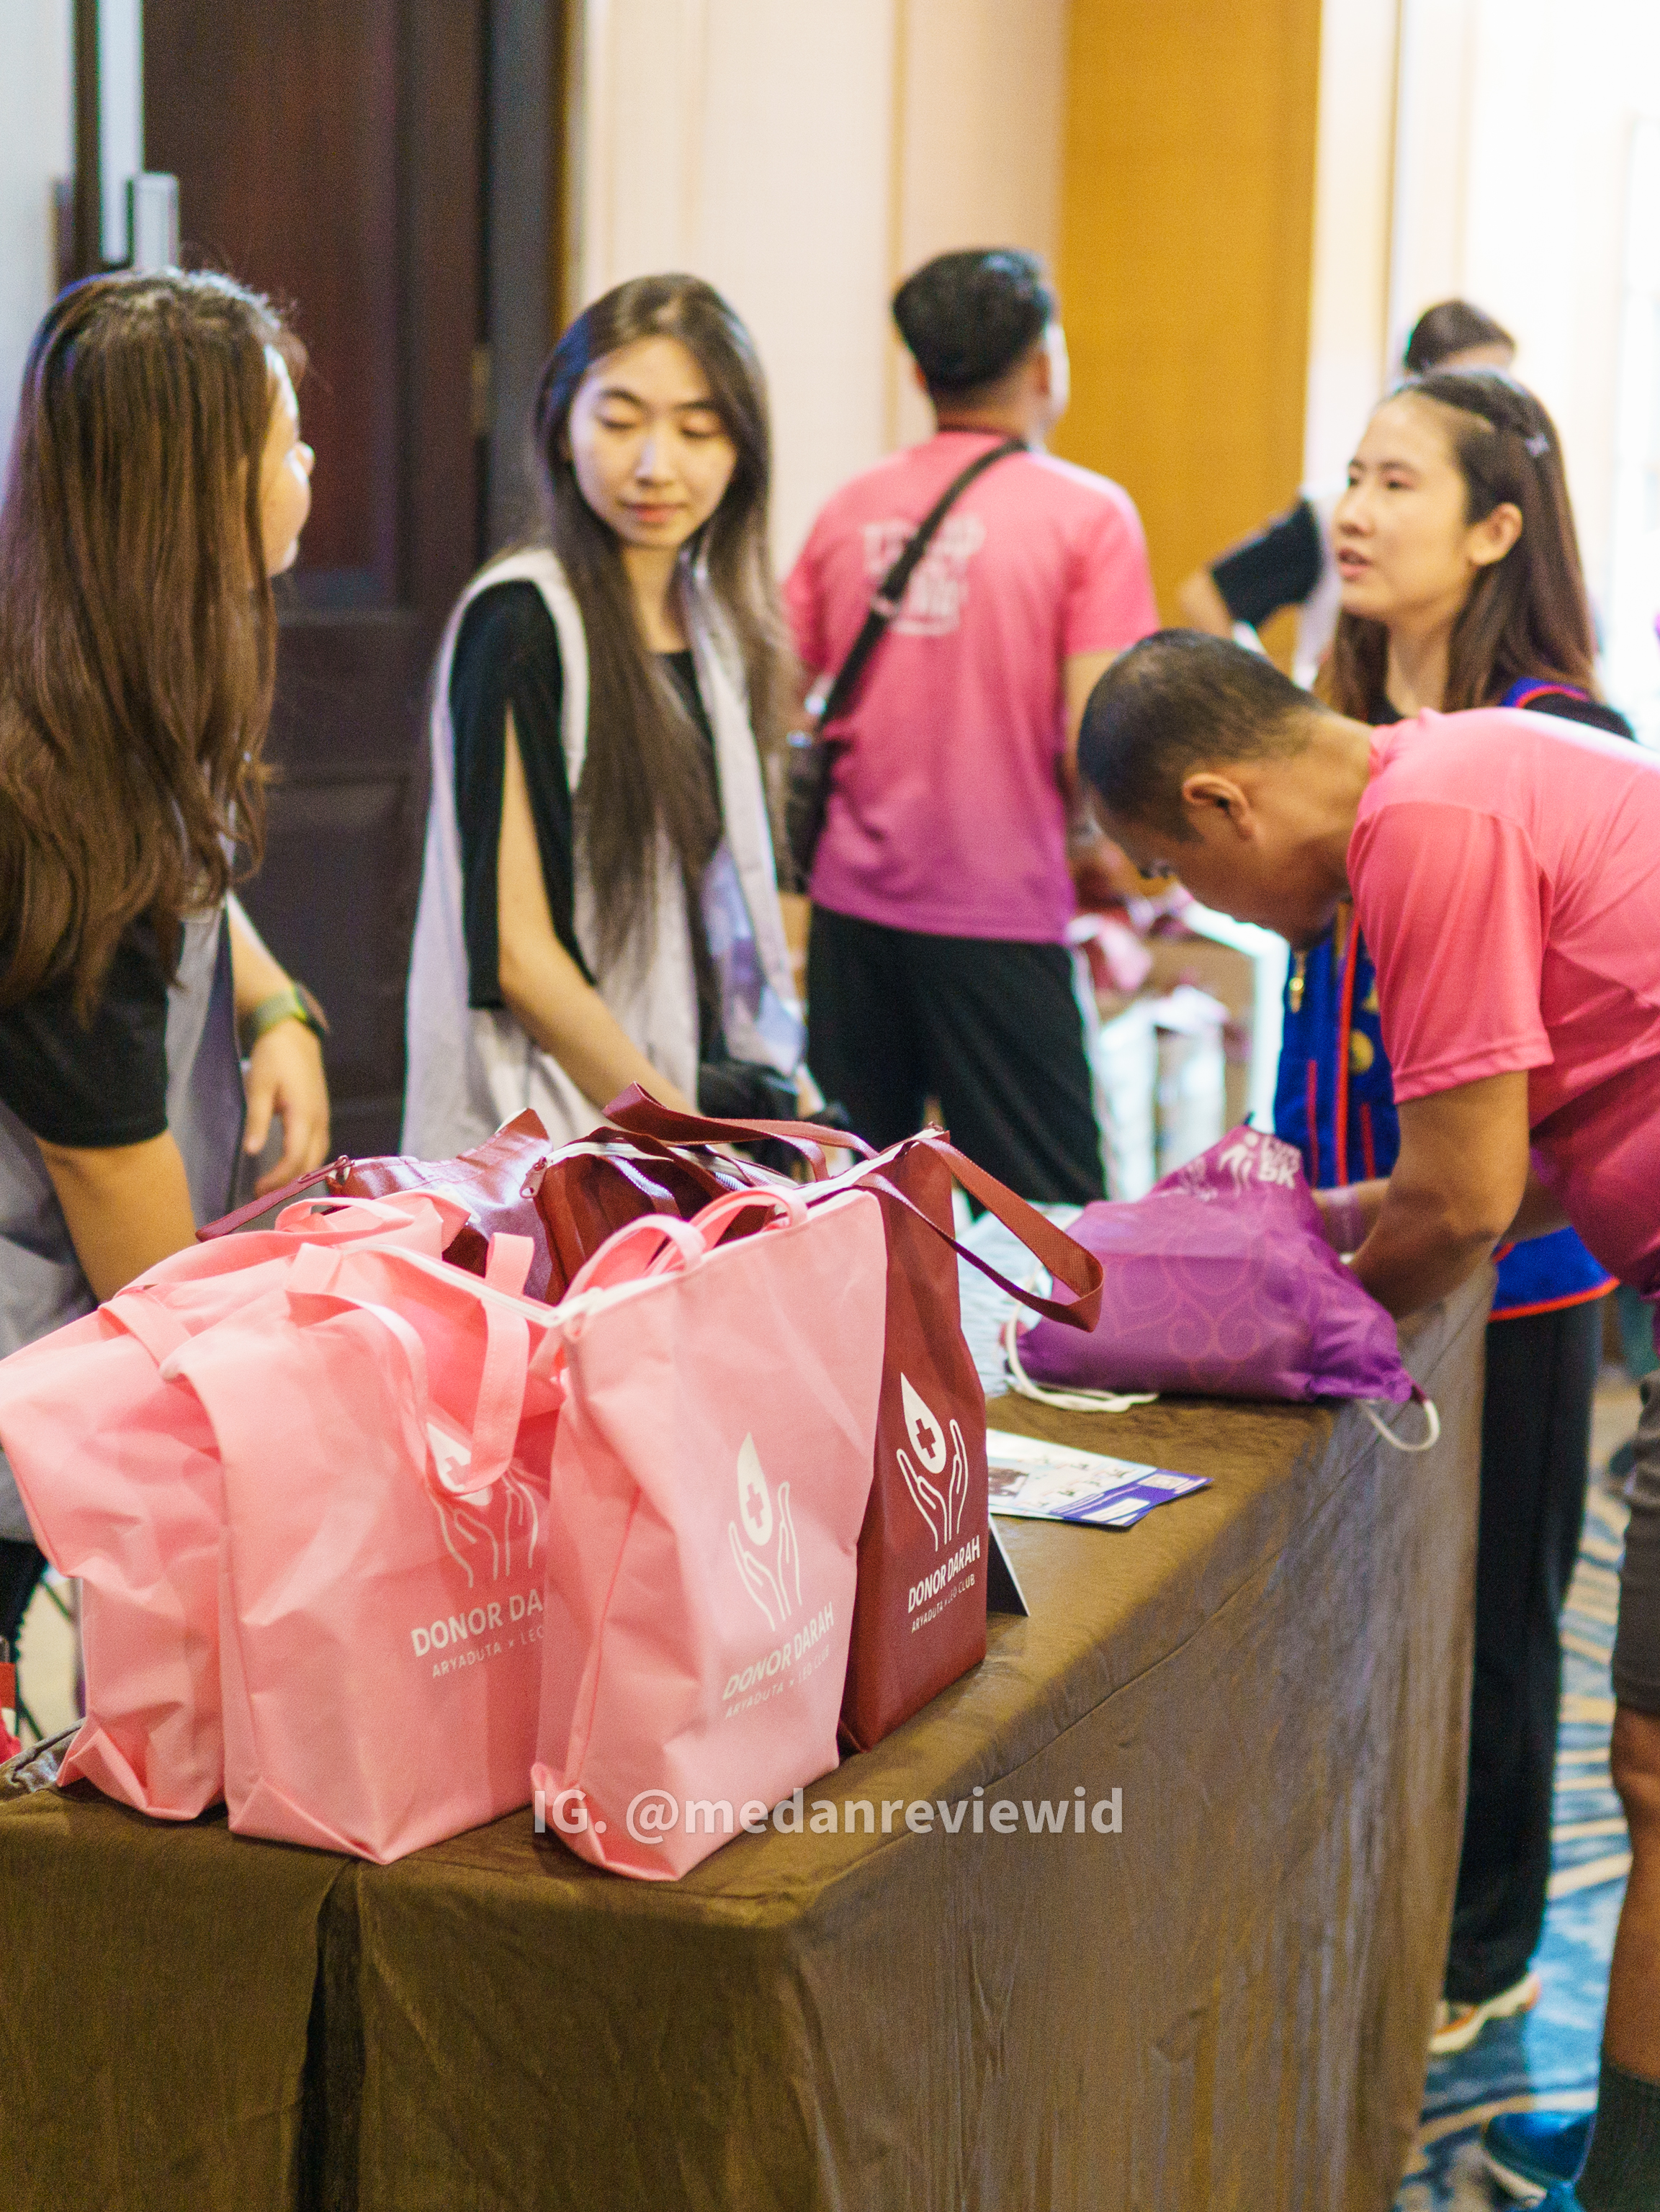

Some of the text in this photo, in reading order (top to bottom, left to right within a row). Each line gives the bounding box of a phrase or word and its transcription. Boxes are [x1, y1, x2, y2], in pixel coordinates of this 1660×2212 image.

[907, 1534, 980, 1614] DONOR DARAH
[410, 1602, 503, 1657] DONOR
[911, 1601, 943, 1634] ARYADUTA
[958, 1573, 975, 1593] CLUB
[432, 1642, 502, 1678] ARYADUTA
[722, 1601, 834, 1700] DONOR DARAH
[725, 1682, 784, 1719] ARYADUTA
